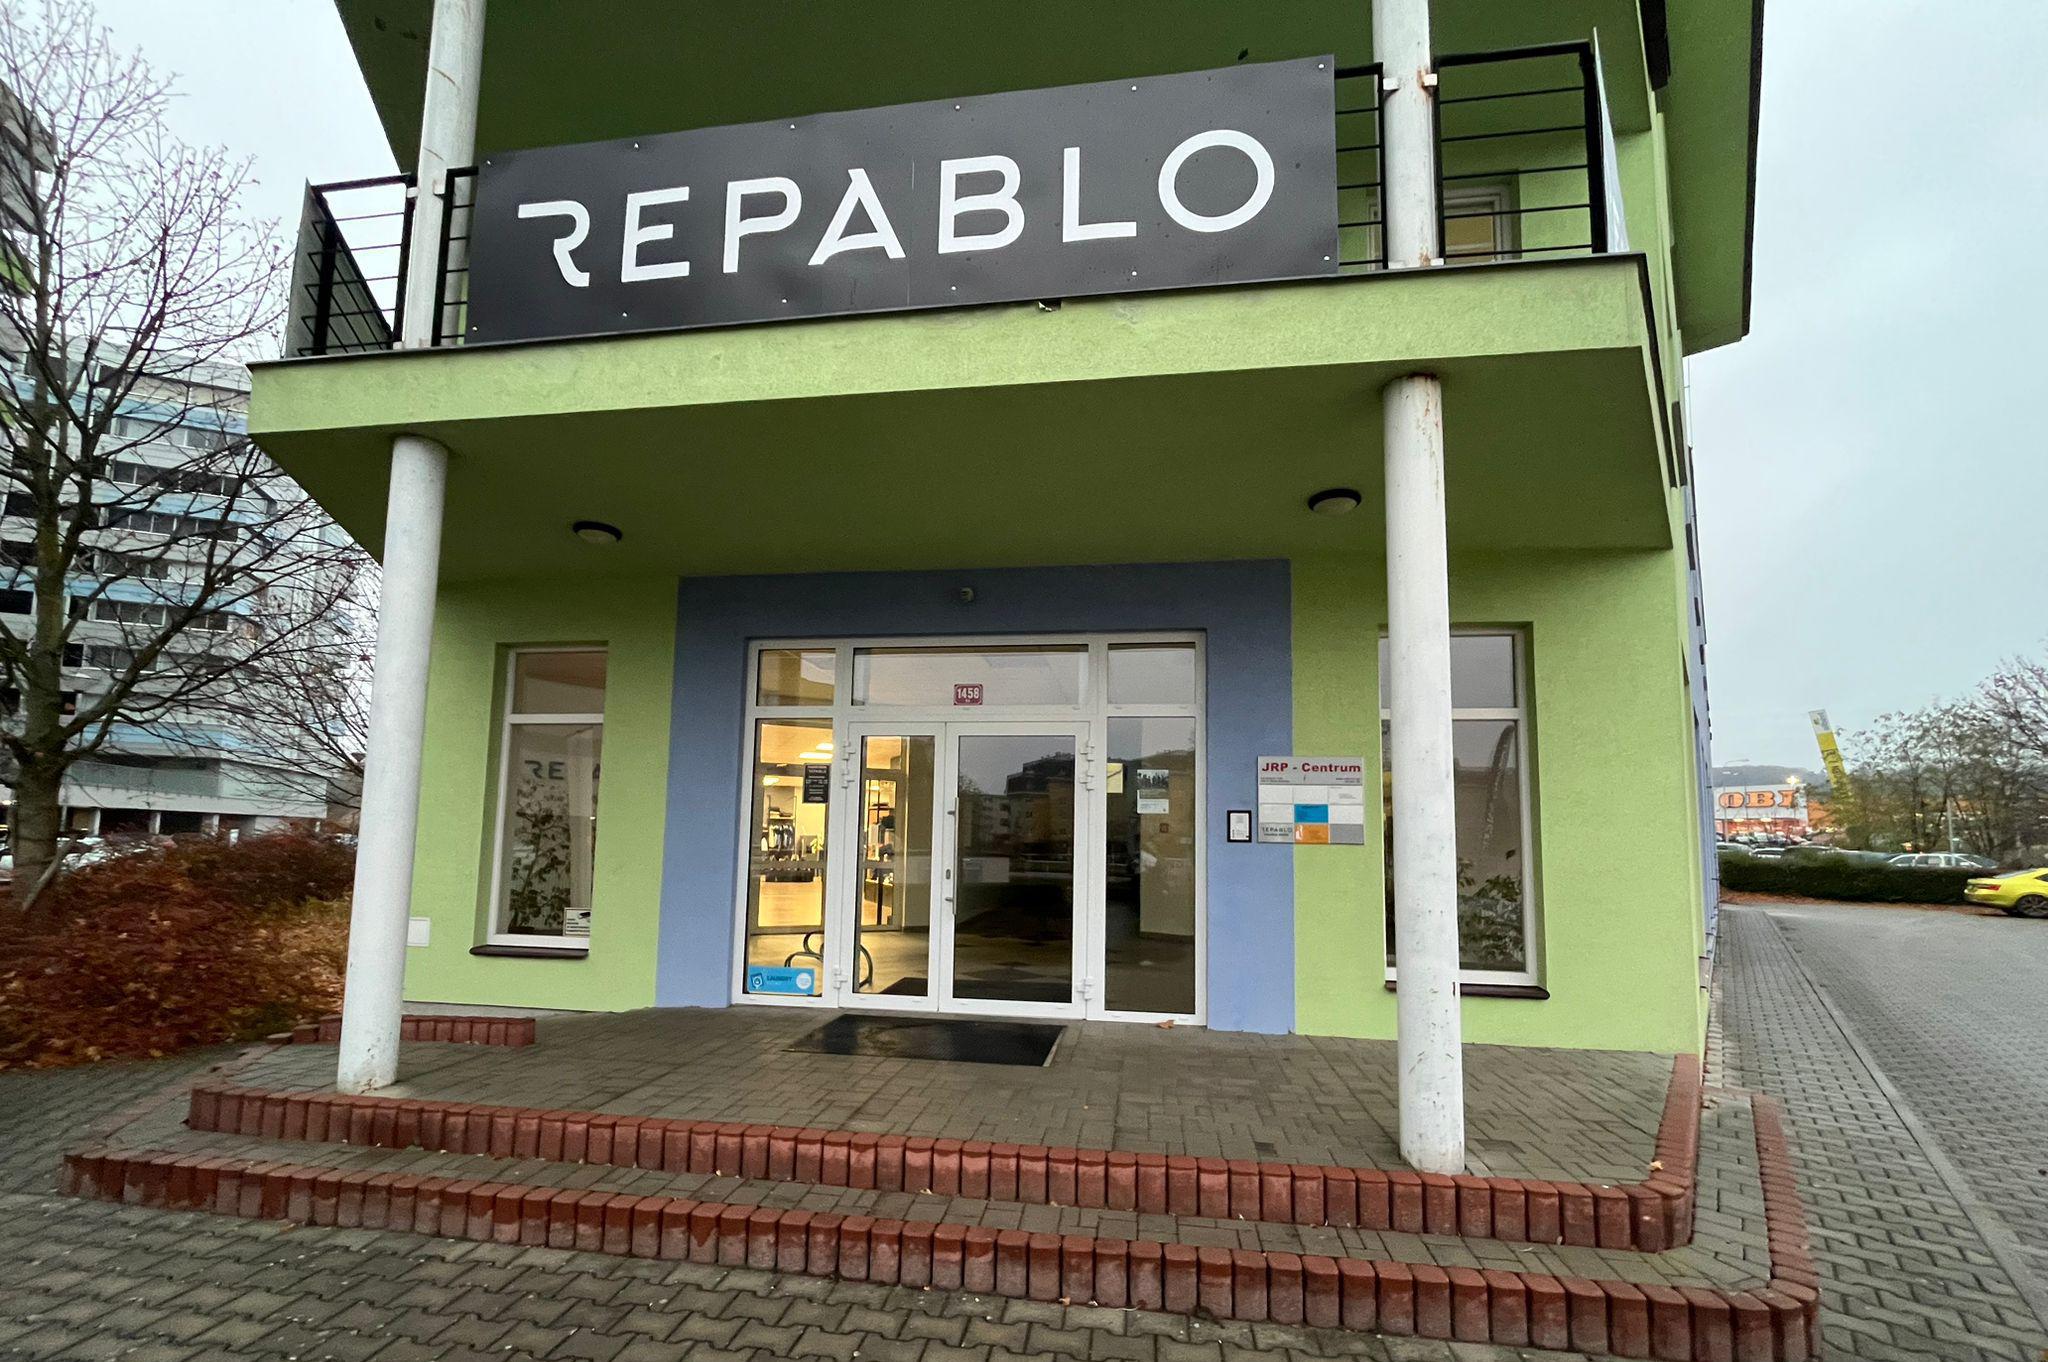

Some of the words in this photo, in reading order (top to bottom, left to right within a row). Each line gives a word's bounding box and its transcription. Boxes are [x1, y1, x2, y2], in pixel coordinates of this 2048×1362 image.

[517, 129, 1276, 288] REPABLO
[957, 687, 980, 699] 1458
[1262, 762, 1288, 772] JRP
[1302, 762, 1361, 772] Centrum
[1719, 789, 1799, 809] OBI
